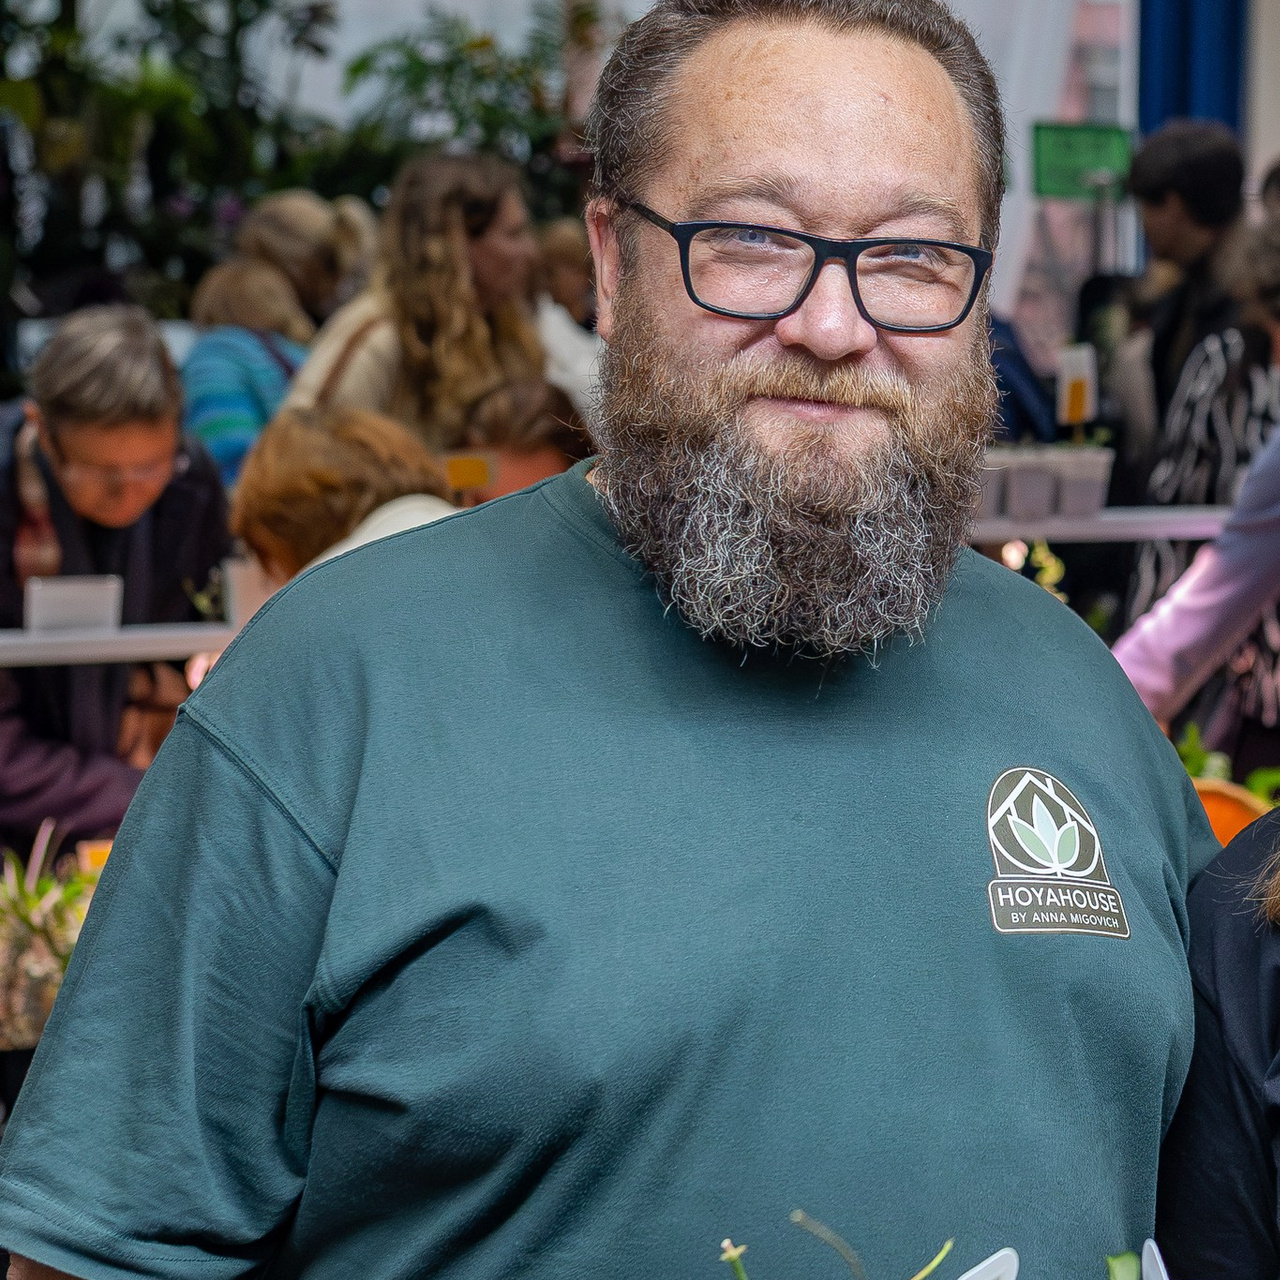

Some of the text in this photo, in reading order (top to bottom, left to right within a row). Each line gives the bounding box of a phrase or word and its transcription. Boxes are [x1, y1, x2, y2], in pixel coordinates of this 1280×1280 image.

[998, 887, 1120, 914] HOYAHOUSE
[1011, 912, 1119, 929] BY ANNA MIGOVICH
